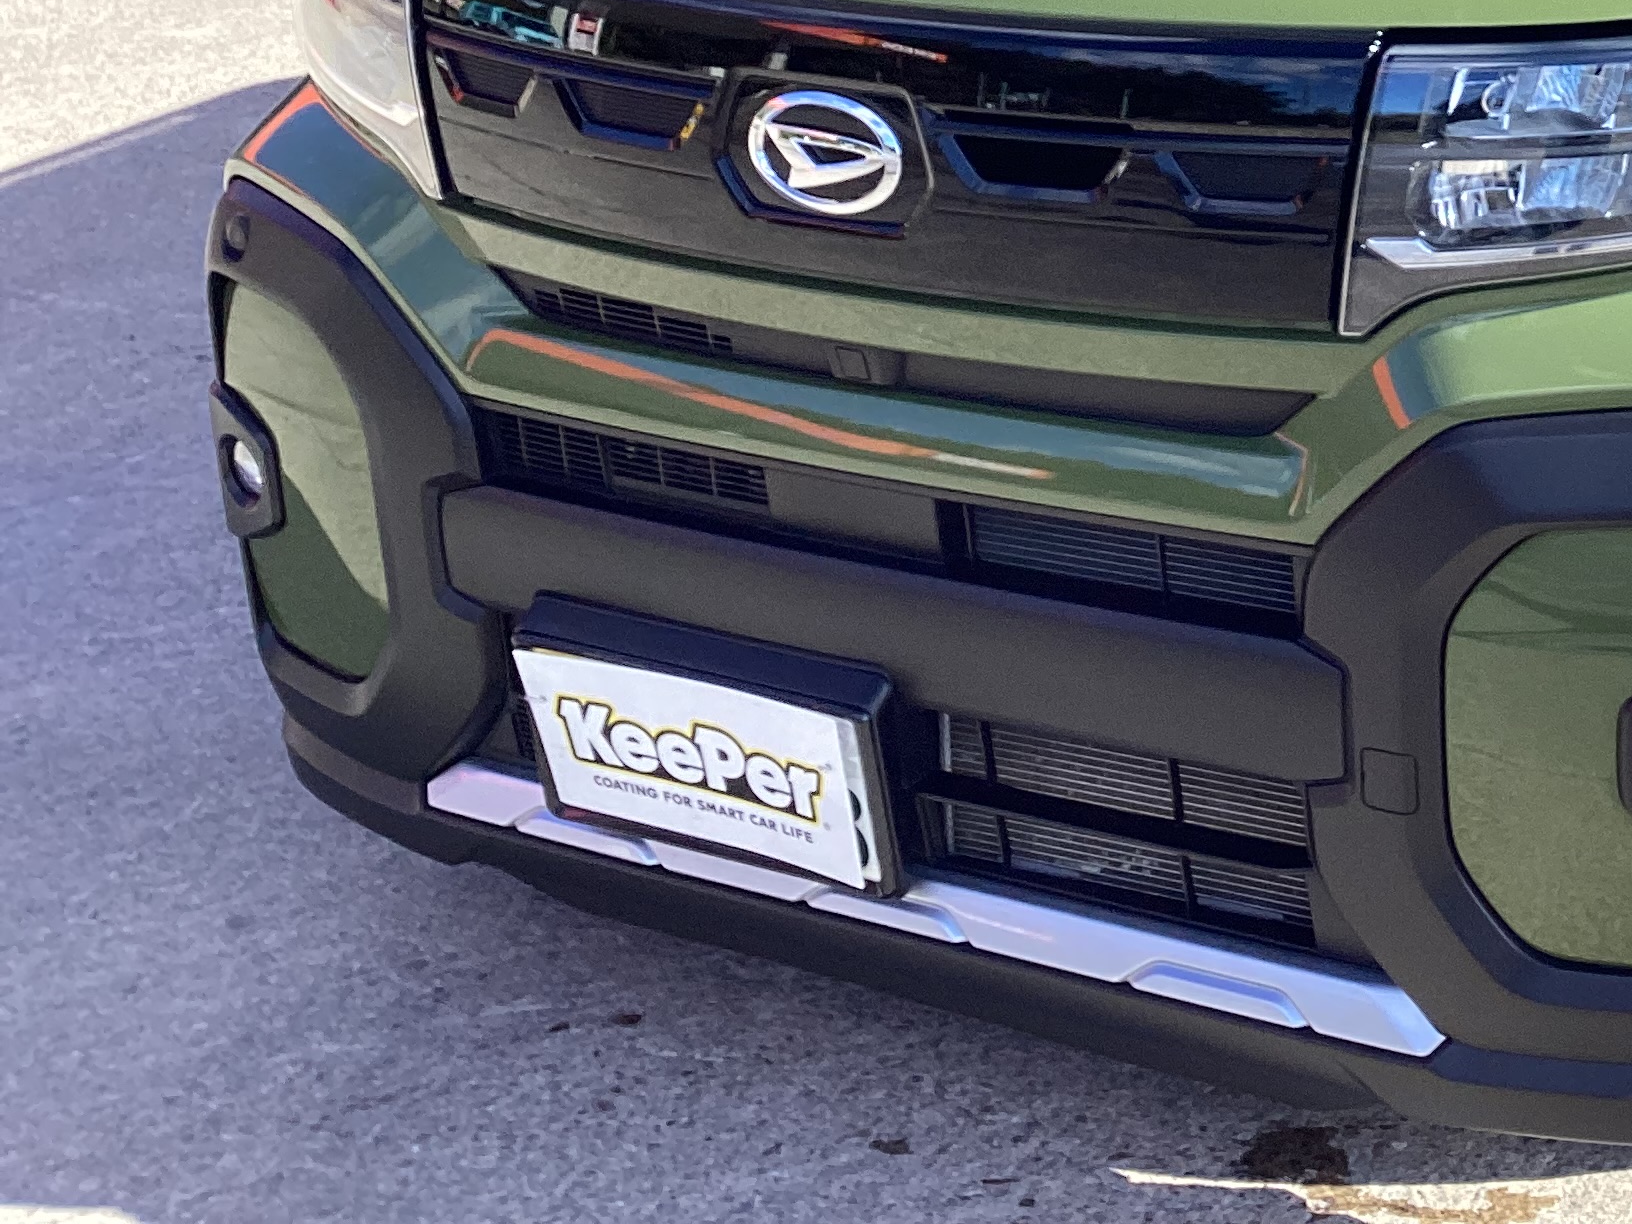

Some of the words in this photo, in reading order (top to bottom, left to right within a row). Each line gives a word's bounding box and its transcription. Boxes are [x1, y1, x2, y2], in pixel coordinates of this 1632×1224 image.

[556, 694, 822, 823] KeePer
[593, 775, 659, 799] COATING
[662, 791, 693, 807] FOR
[696, 799, 744, 821] SMART
[749, 813, 778, 832] CAR
[781, 823, 815, 844] LIFE
